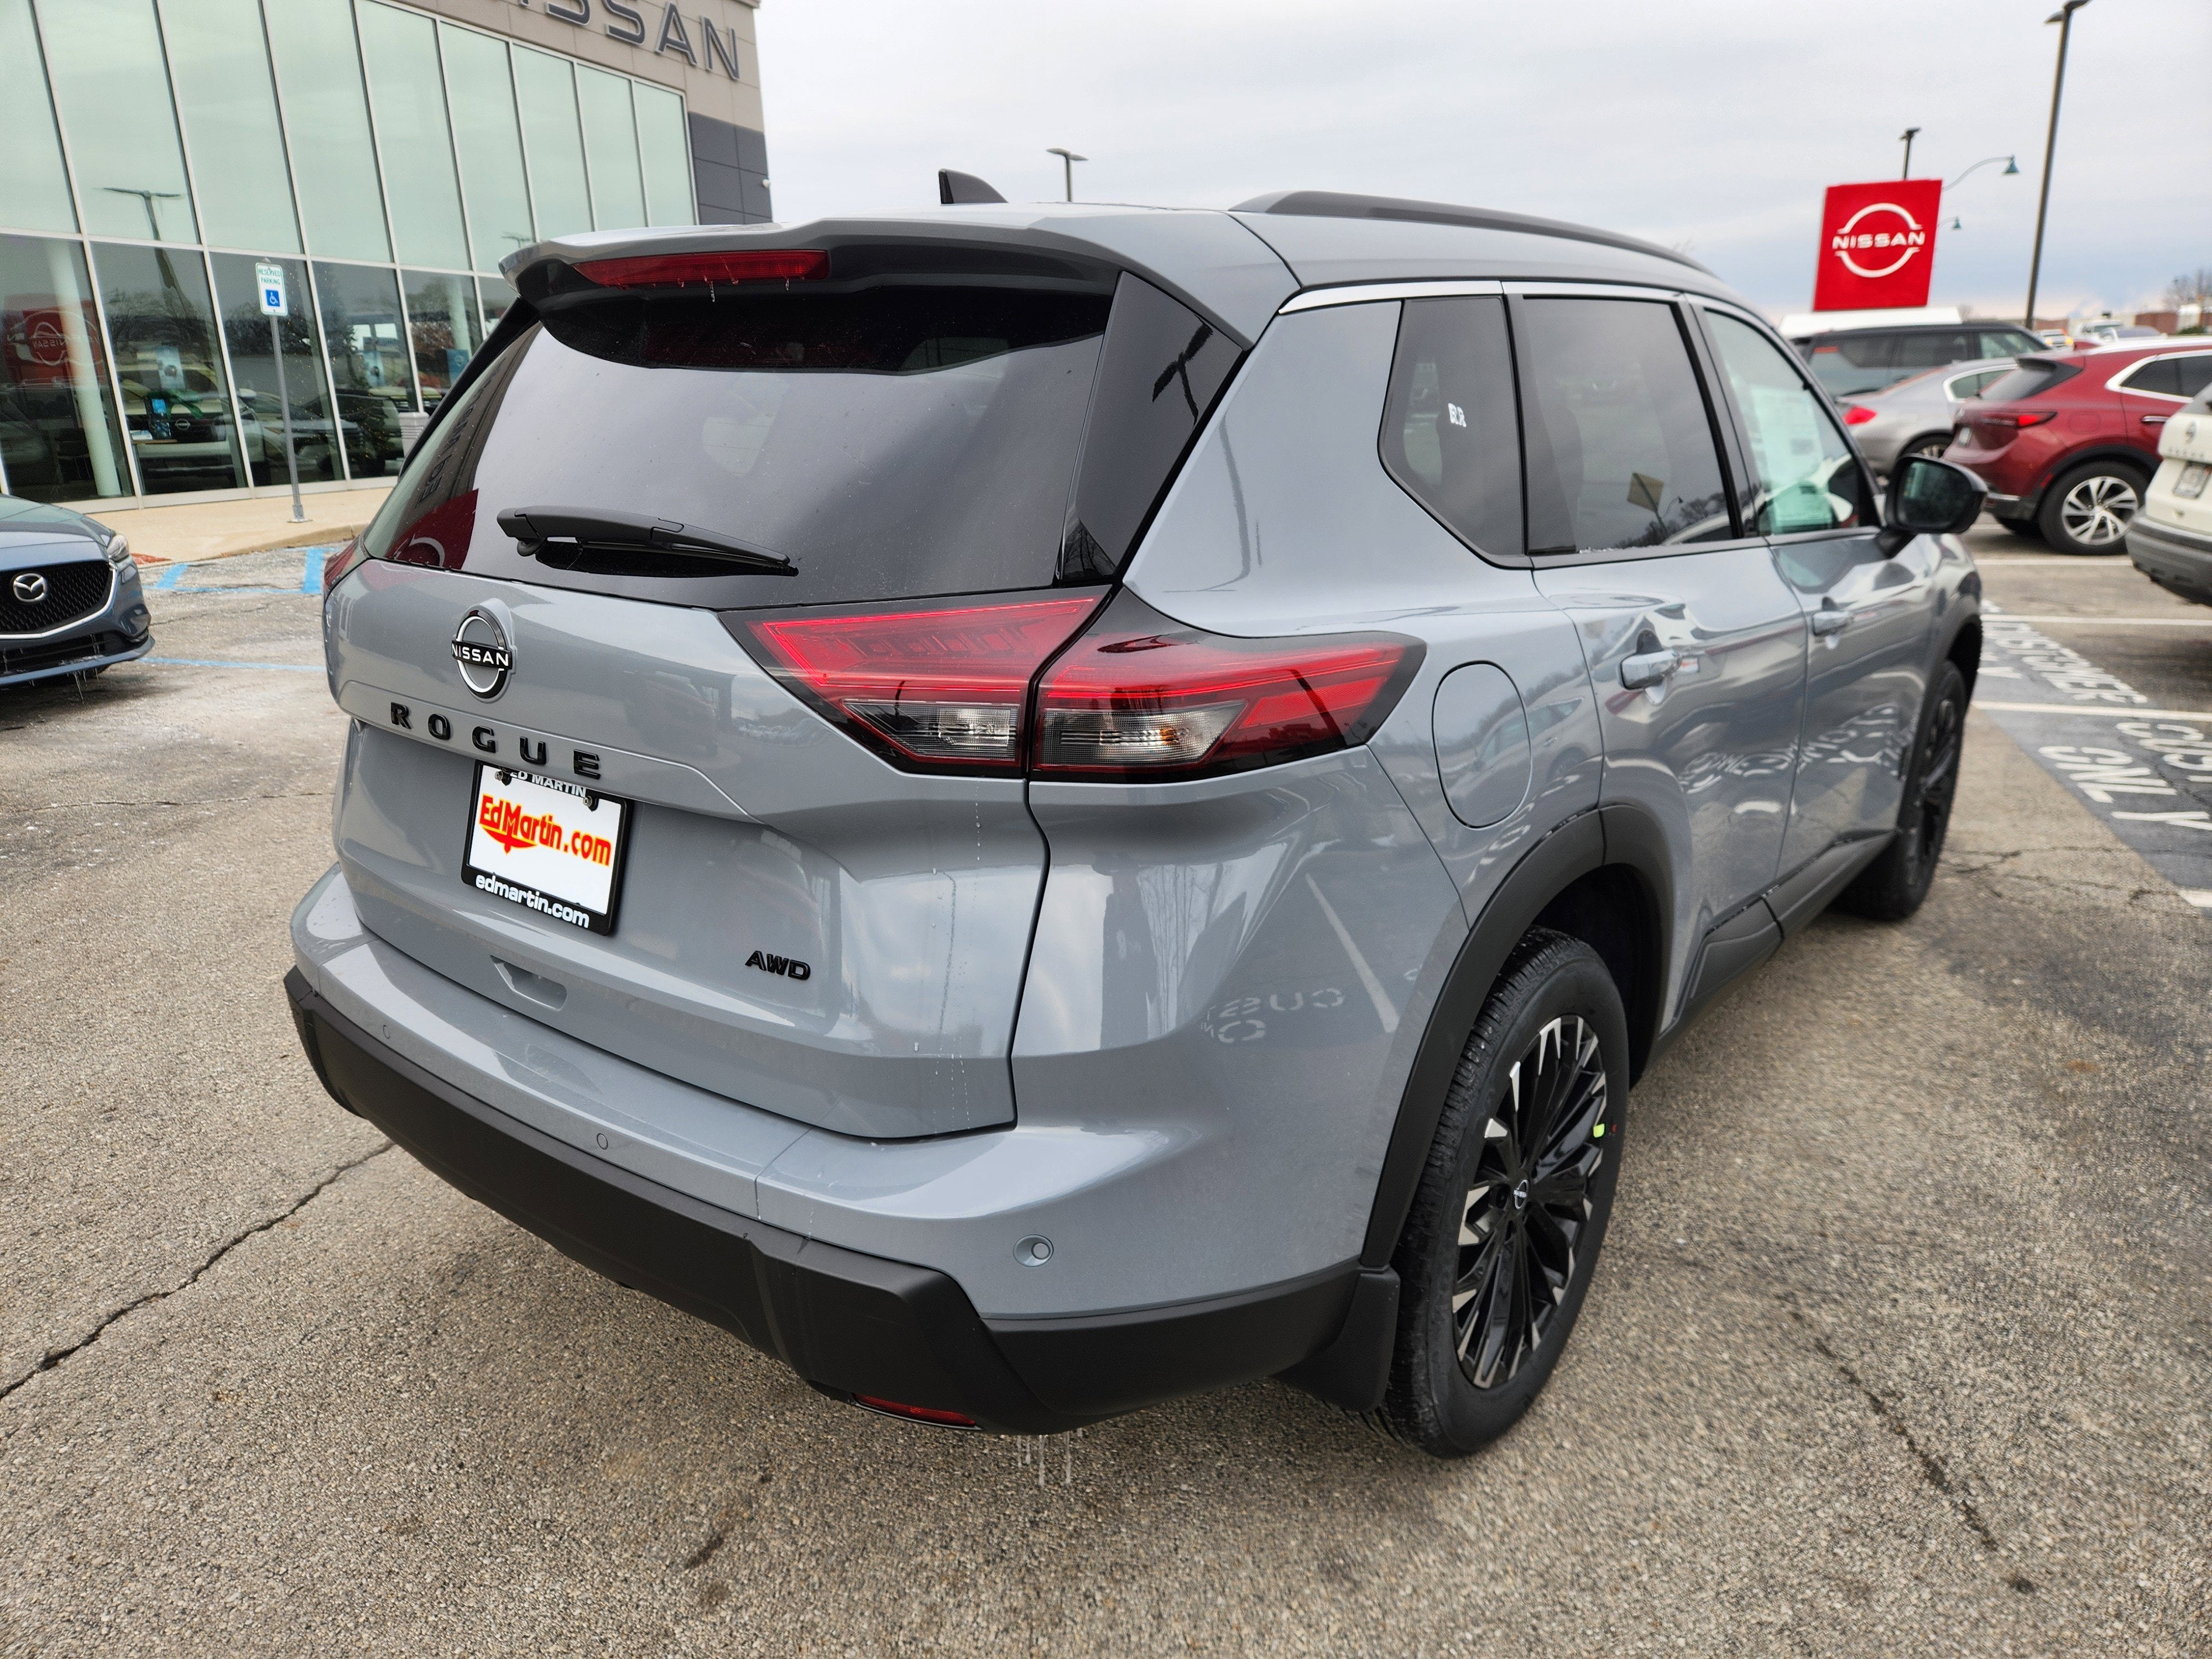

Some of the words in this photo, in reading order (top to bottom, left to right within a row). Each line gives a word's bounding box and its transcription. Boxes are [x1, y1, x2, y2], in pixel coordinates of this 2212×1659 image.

[1832, 231, 1926, 249] NISSAN
[258, 268, 281, 277] RESERVED
[451, 643, 509, 667] NISSAN
[390, 702, 601, 780] ROGUE
[531, 774, 587, 798] MARTIN
[476, 873, 590, 929] edmartin.com
[744, 950, 811, 981] AWD
